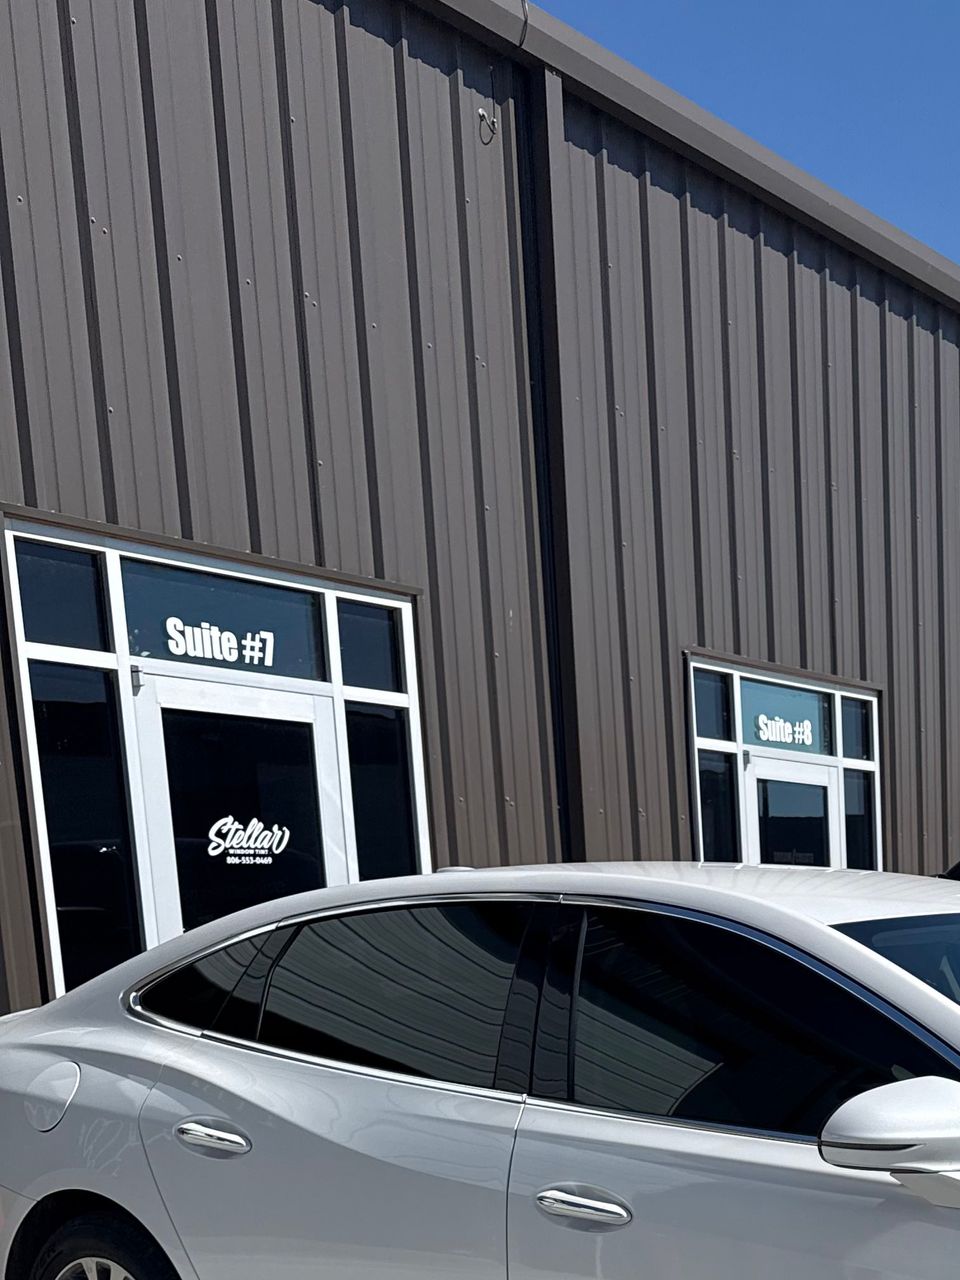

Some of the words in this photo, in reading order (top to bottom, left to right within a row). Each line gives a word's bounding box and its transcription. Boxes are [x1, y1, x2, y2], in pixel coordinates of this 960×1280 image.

[166, 617, 238, 662] Suite
[242, 631, 275, 667] #7
[759, 714, 793, 744] Suite
[793, 720, 813, 746] #8
[208, 815, 290, 856] Stellar
